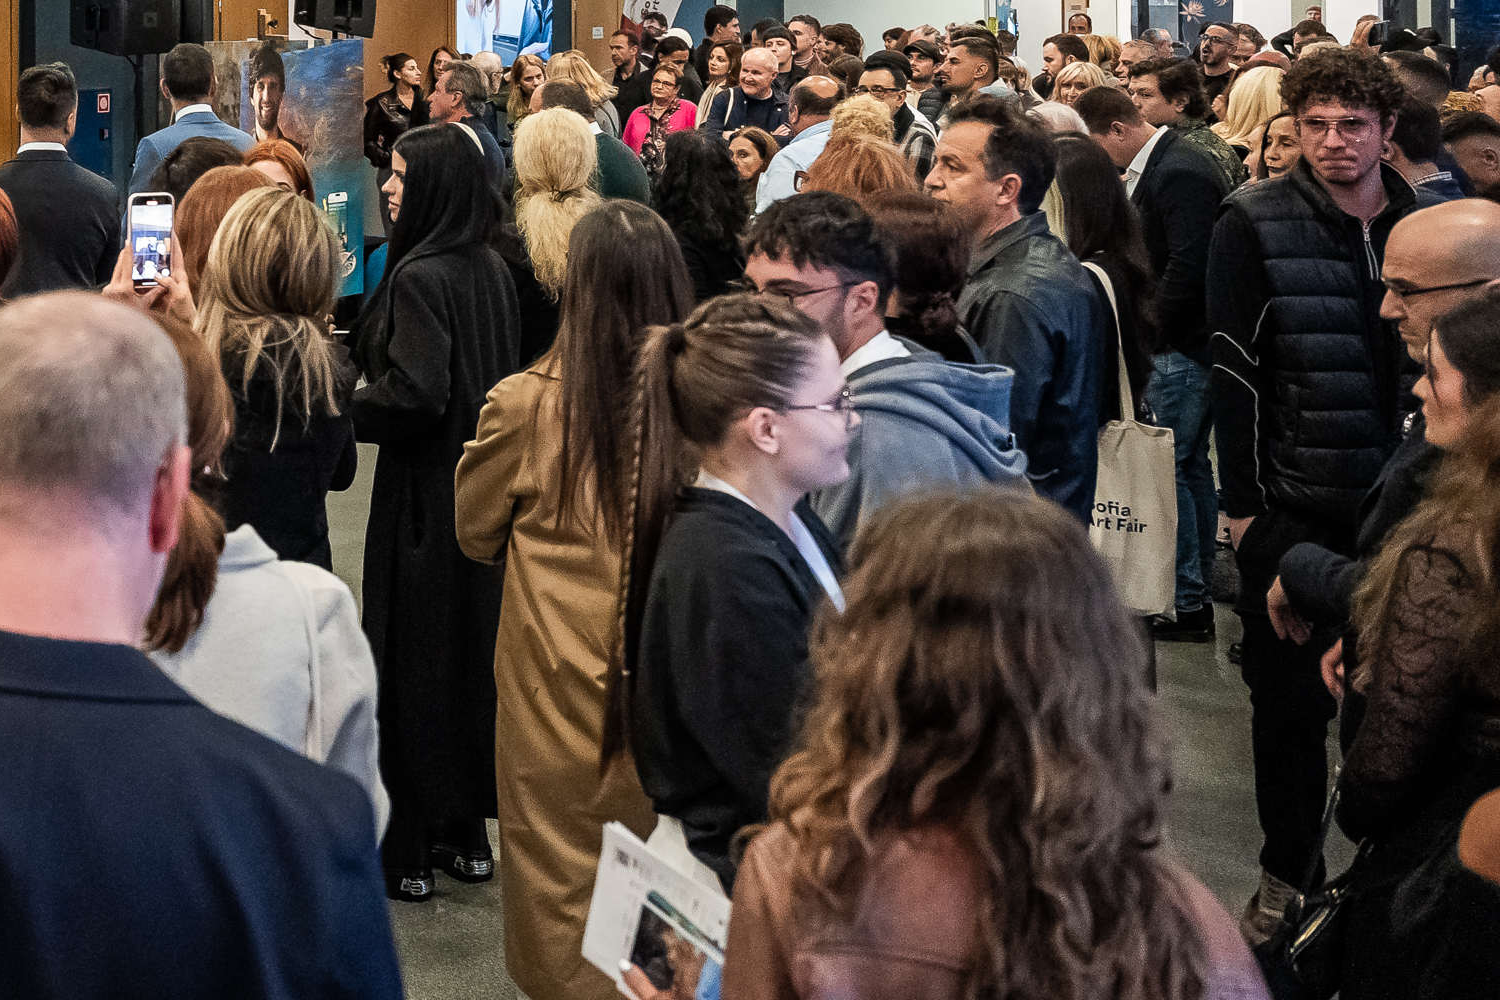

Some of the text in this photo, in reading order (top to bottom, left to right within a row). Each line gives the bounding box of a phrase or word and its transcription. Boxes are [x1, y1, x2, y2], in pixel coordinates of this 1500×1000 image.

[652, 0, 660, 11] rt
[1095, 500, 1131, 517] ofia
[1116, 517, 1148, 534] Fair
